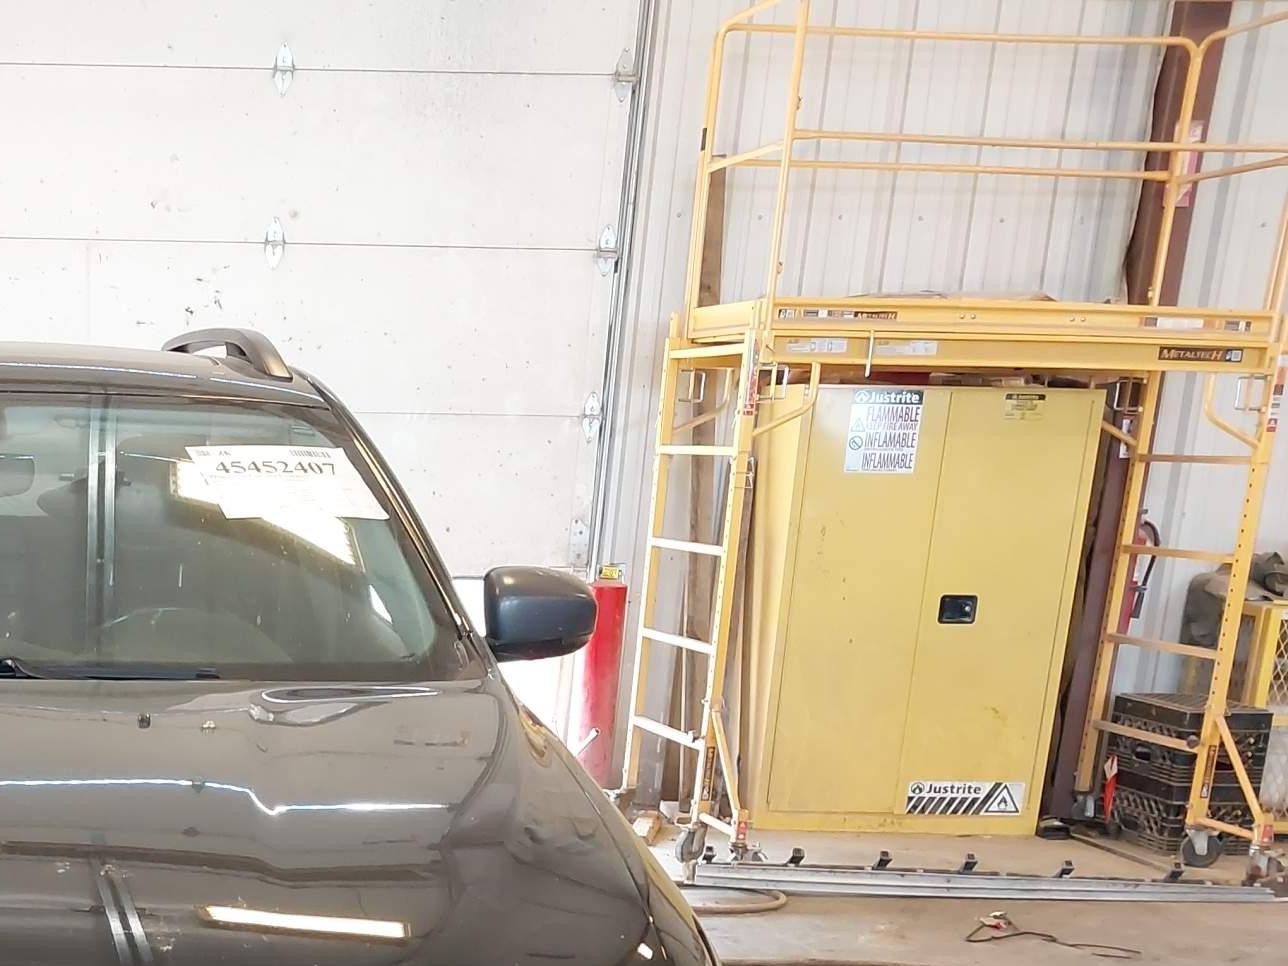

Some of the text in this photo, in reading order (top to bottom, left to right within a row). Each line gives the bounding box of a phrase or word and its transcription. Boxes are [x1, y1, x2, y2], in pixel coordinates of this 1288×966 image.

[870, 391, 920, 403] Justrite
[867, 406, 920, 422] FLAMMABLE
[864, 432, 917, 448] INFLAMABLE
[216, 460, 336, 475] 45452407
[861, 452, 914, 469] INFLAMMABLE
[926, 783, 982, 794] Justrite
